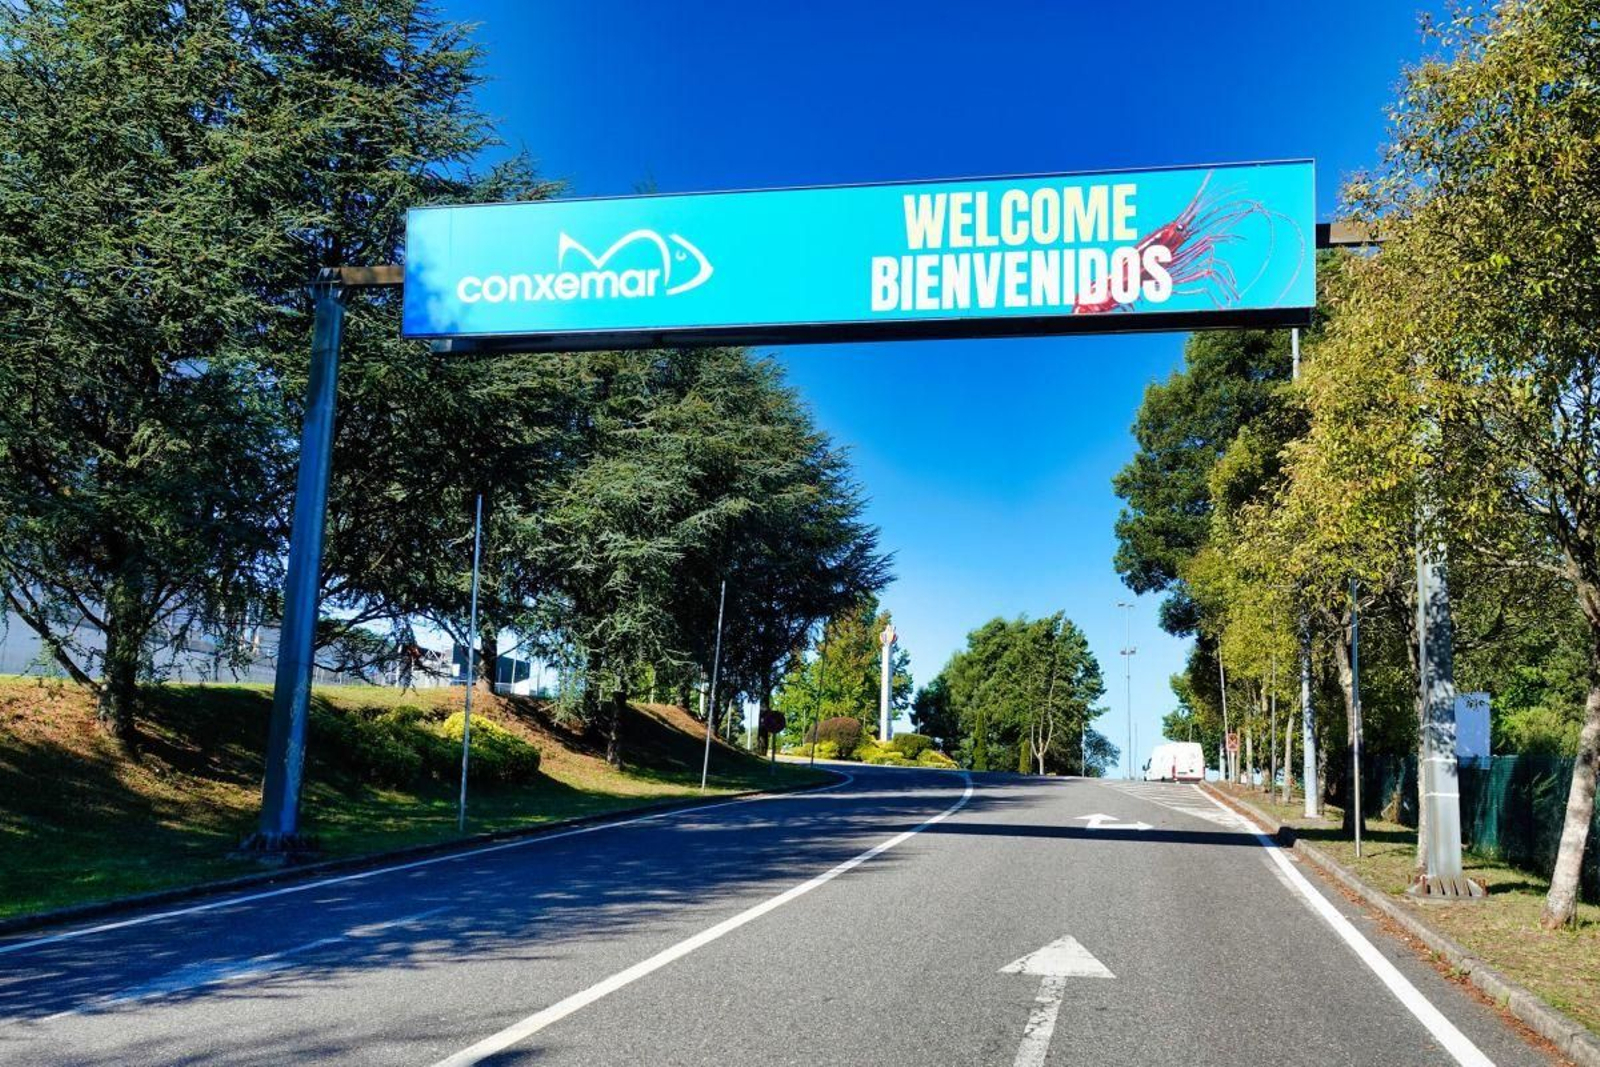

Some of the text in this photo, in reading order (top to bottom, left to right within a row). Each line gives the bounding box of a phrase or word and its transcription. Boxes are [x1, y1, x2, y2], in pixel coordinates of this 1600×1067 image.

[903, 183, 1138, 250] WELCOME
[456, 267, 661, 304] conxemar
[871, 244, 1173, 312] BIENVENIDOS
